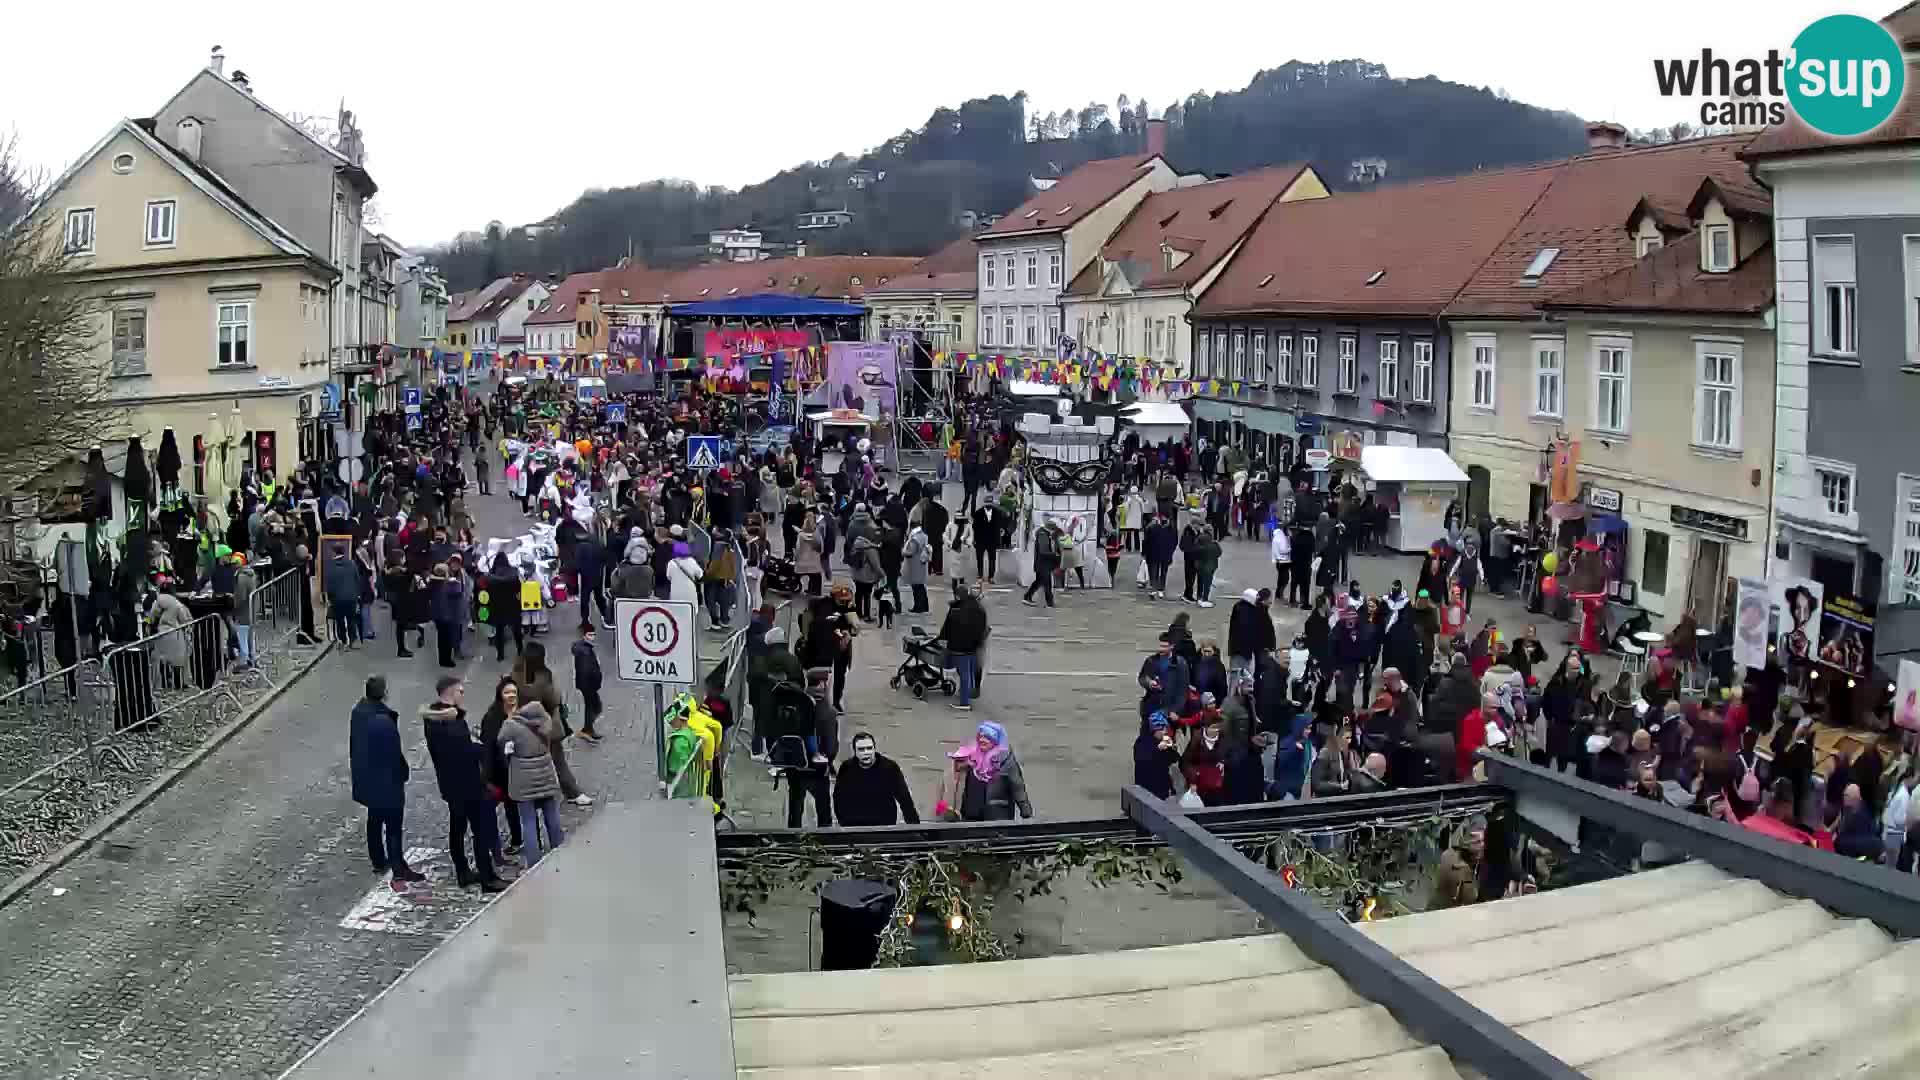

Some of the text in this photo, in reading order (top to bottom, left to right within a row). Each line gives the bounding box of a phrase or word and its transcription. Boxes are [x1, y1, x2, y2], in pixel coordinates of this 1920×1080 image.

[408, 391, 416, 403] P
[643, 622, 667, 642] 30
[633, 659, 679, 677] ZONA
